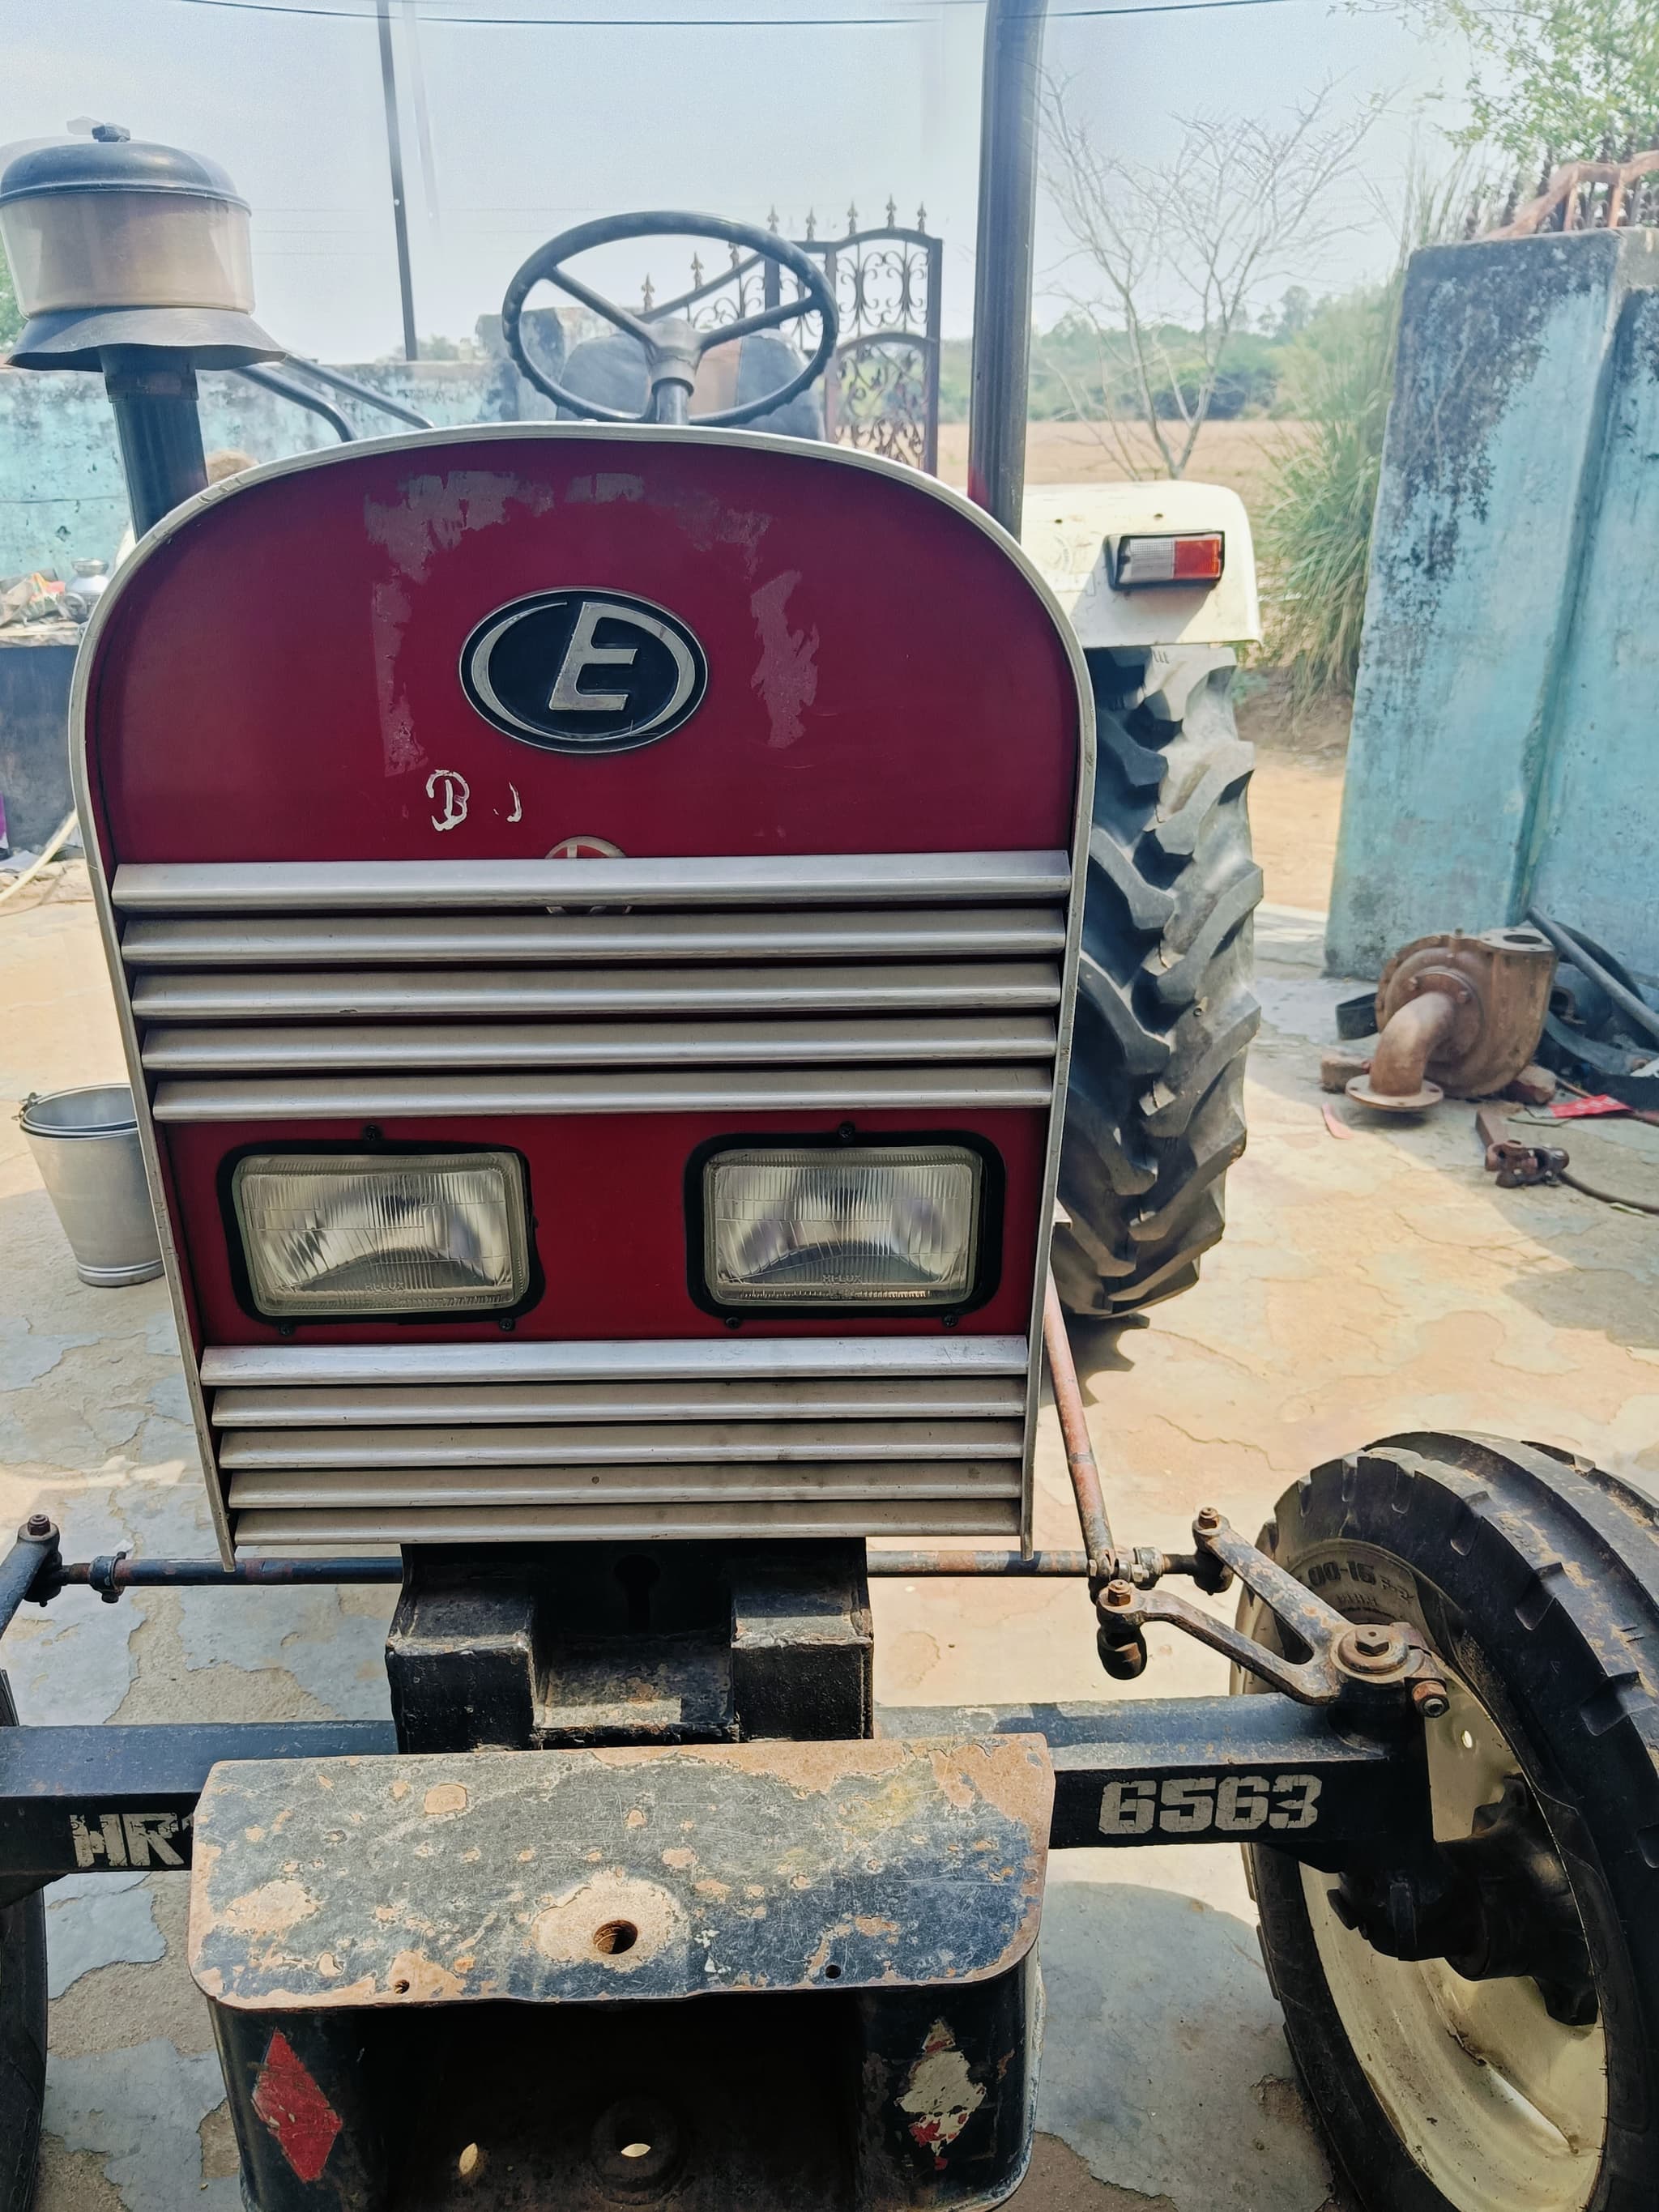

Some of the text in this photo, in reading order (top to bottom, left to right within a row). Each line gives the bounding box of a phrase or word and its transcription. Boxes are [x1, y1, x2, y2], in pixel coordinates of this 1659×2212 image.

[548, 600, 638, 712] E
[1098, 1774, 1323, 1835] 6563
[69, 1812, 194, 1868] HR
